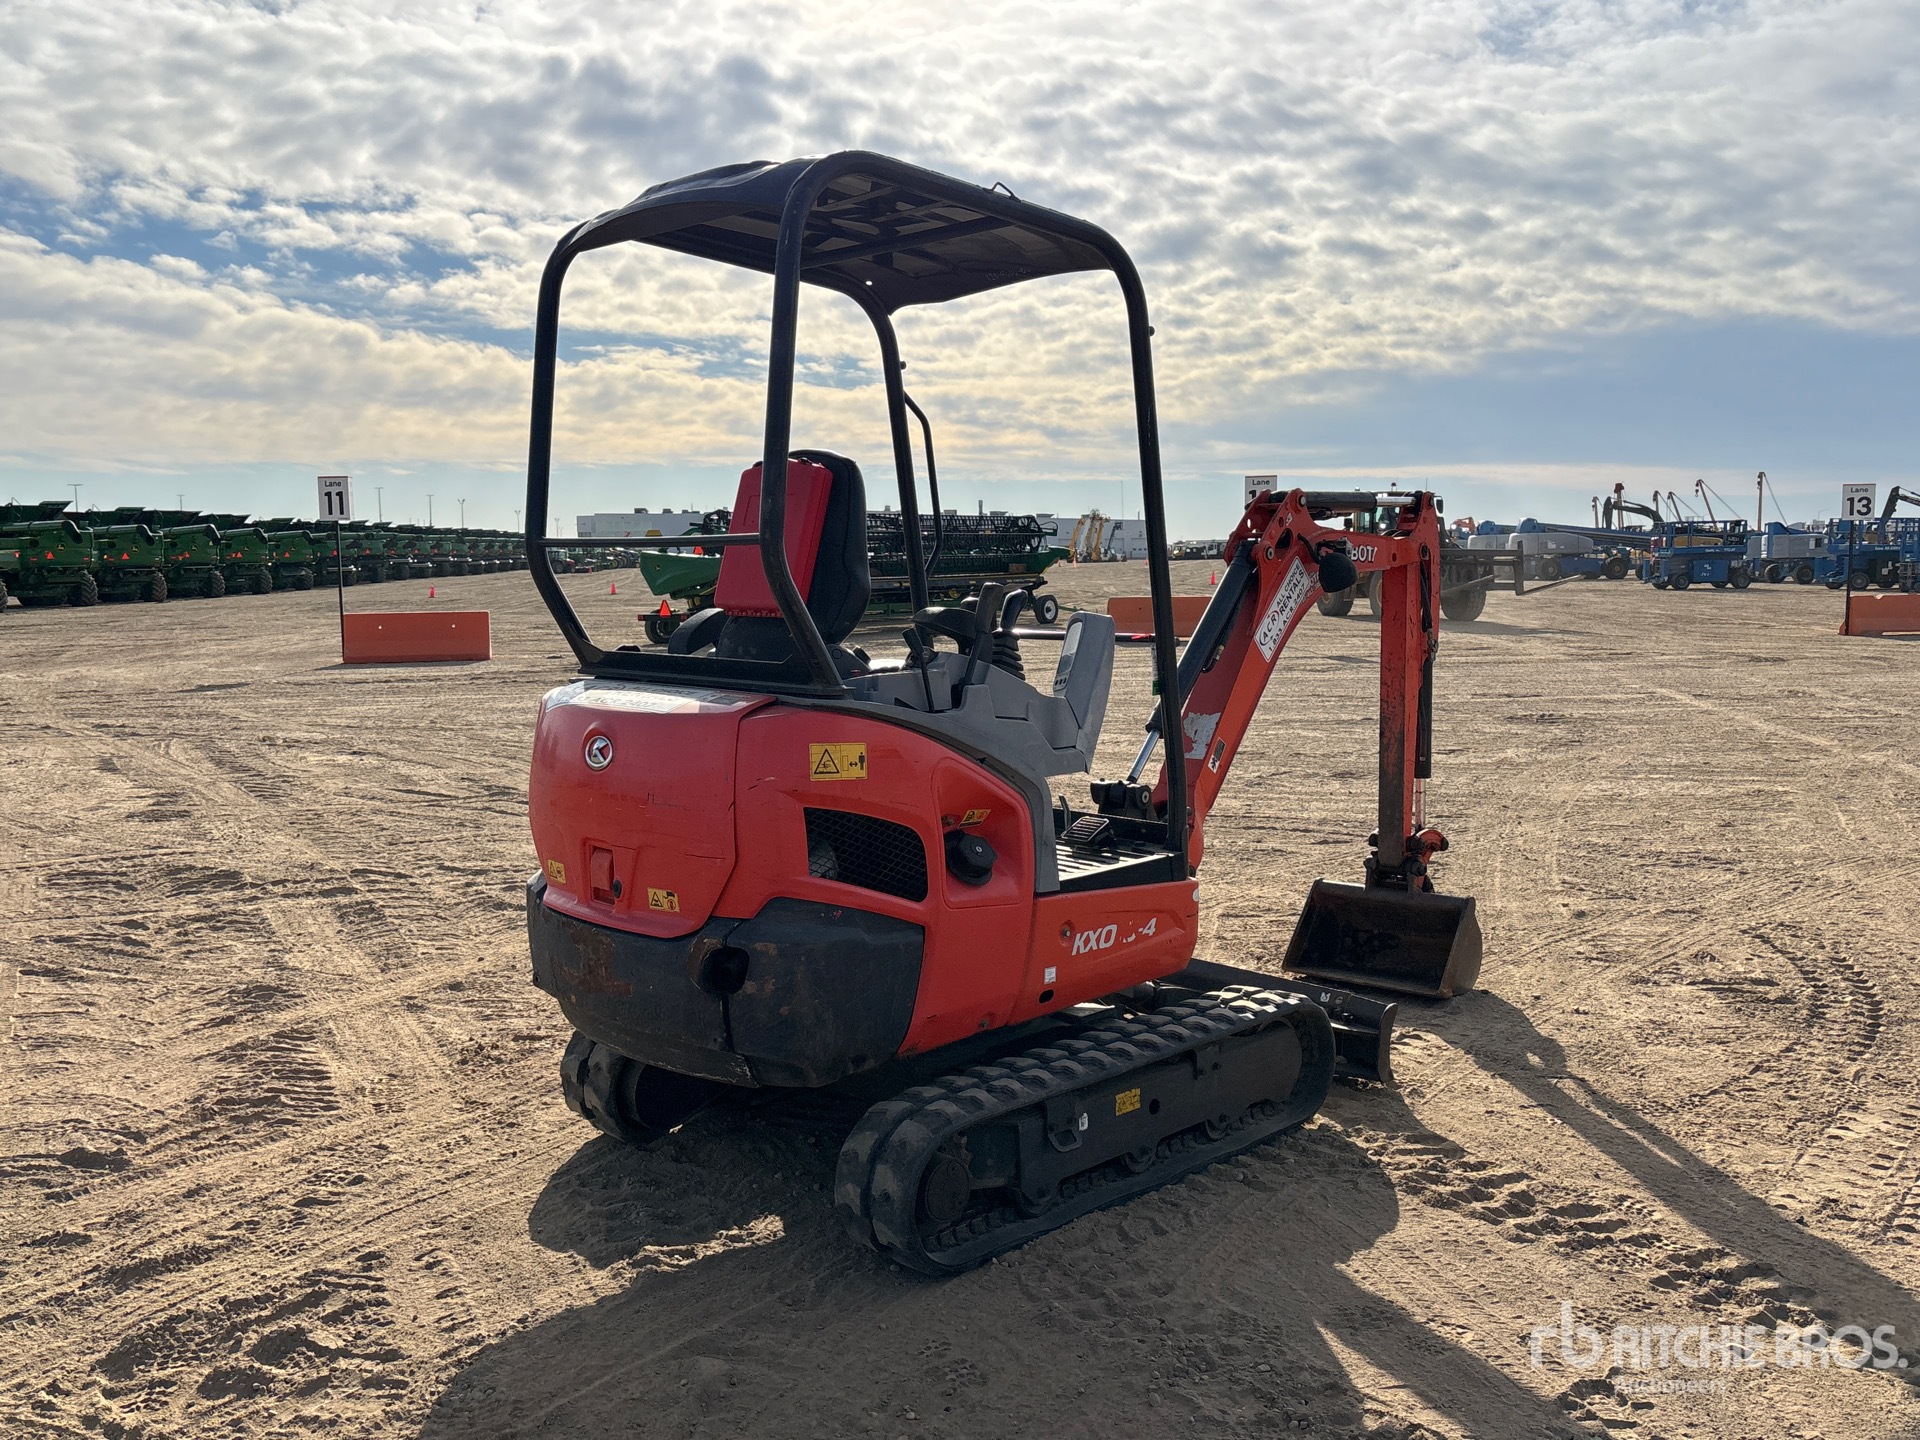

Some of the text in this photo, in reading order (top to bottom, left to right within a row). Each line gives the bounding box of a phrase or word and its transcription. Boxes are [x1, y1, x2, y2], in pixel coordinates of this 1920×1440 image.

[324, 491, 344, 515] 11
[1846, 496, 1872, 516] 13
[1276, 563, 1301, 607] ALL CHOICE
[1278, 569, 1305, 616] RENTALS
[1262, 614, 1277, 641] ACR
